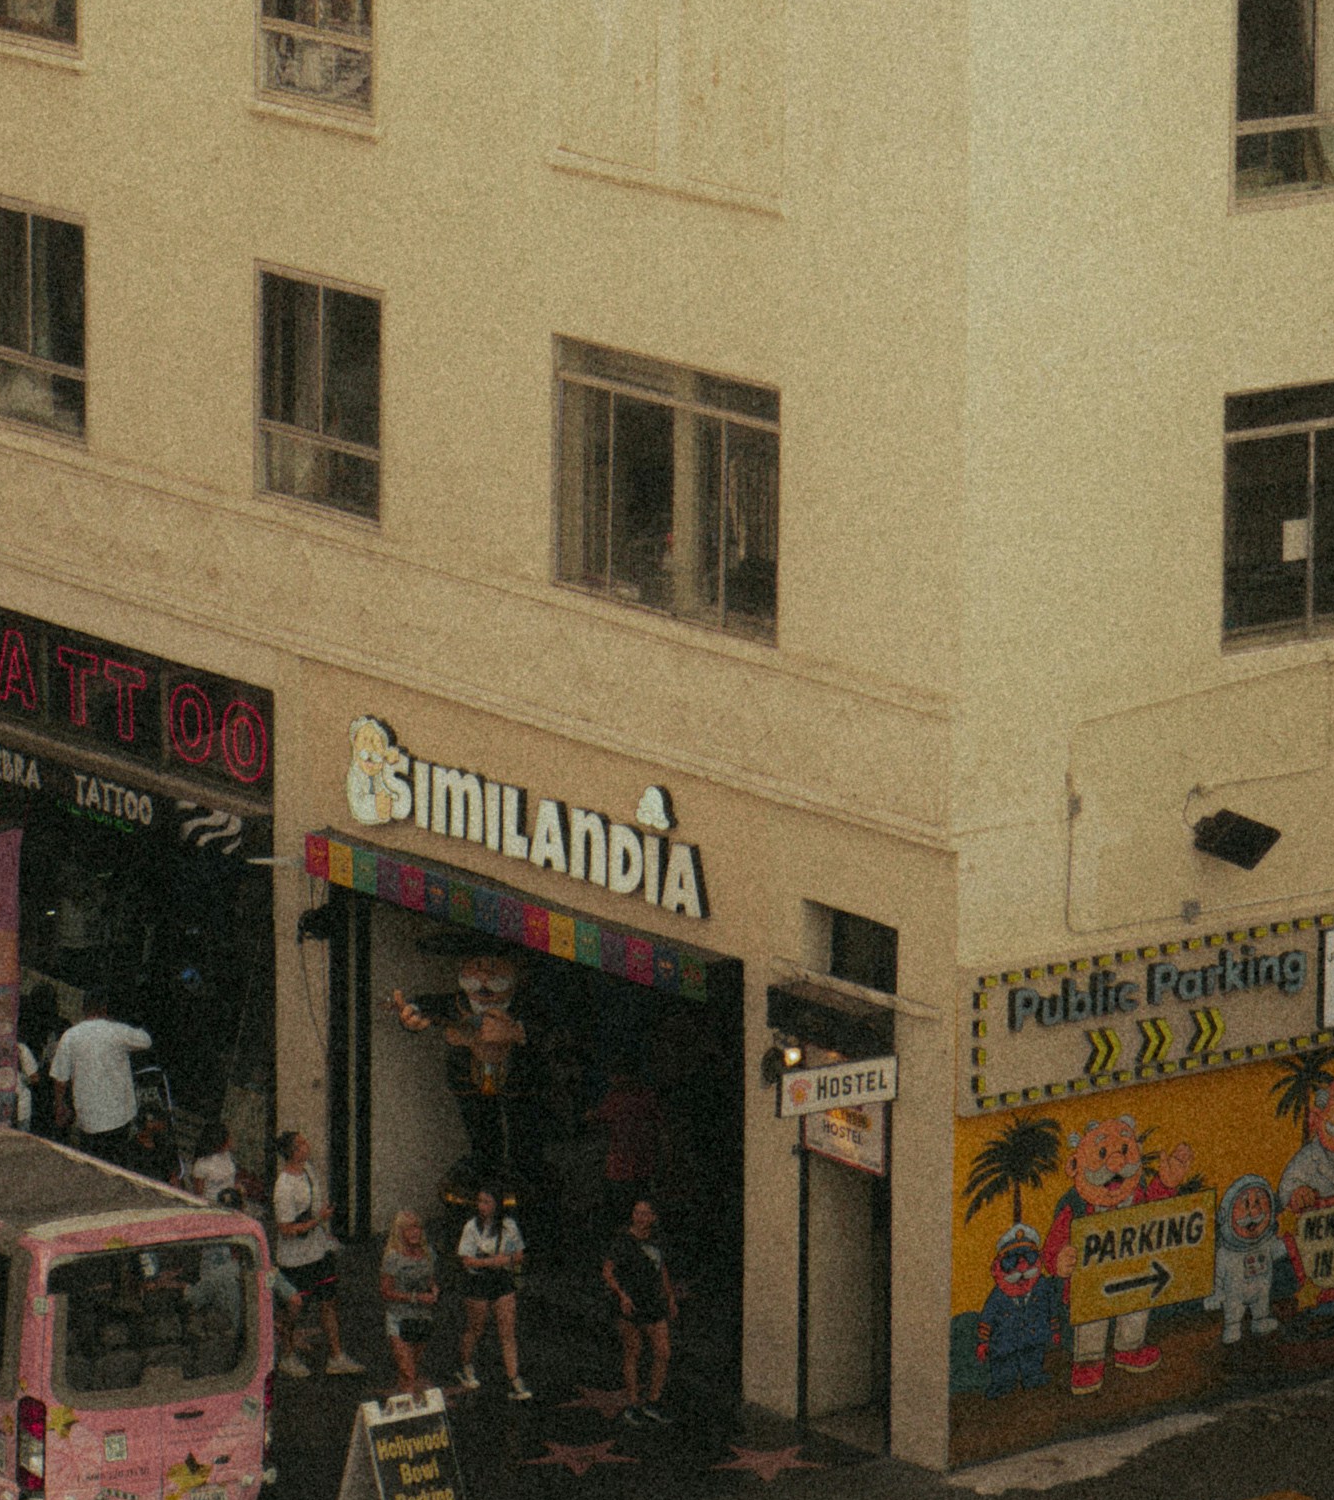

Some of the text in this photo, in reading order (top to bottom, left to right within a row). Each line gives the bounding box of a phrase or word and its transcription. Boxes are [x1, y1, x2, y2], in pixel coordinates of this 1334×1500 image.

[73, 773, 154, 827] TATTOO
[1009, 944, 1307, 1031] Public Parking
[816, 1069, 887, 1099] HOSTEL
[1082, 1209, 1205, 1267] PARKING
[1313, 1249, 1333, 1278] IN
[376, 1425, 450, 1462] Hollywood
[398, 1455, 441, 1486] Bowl
